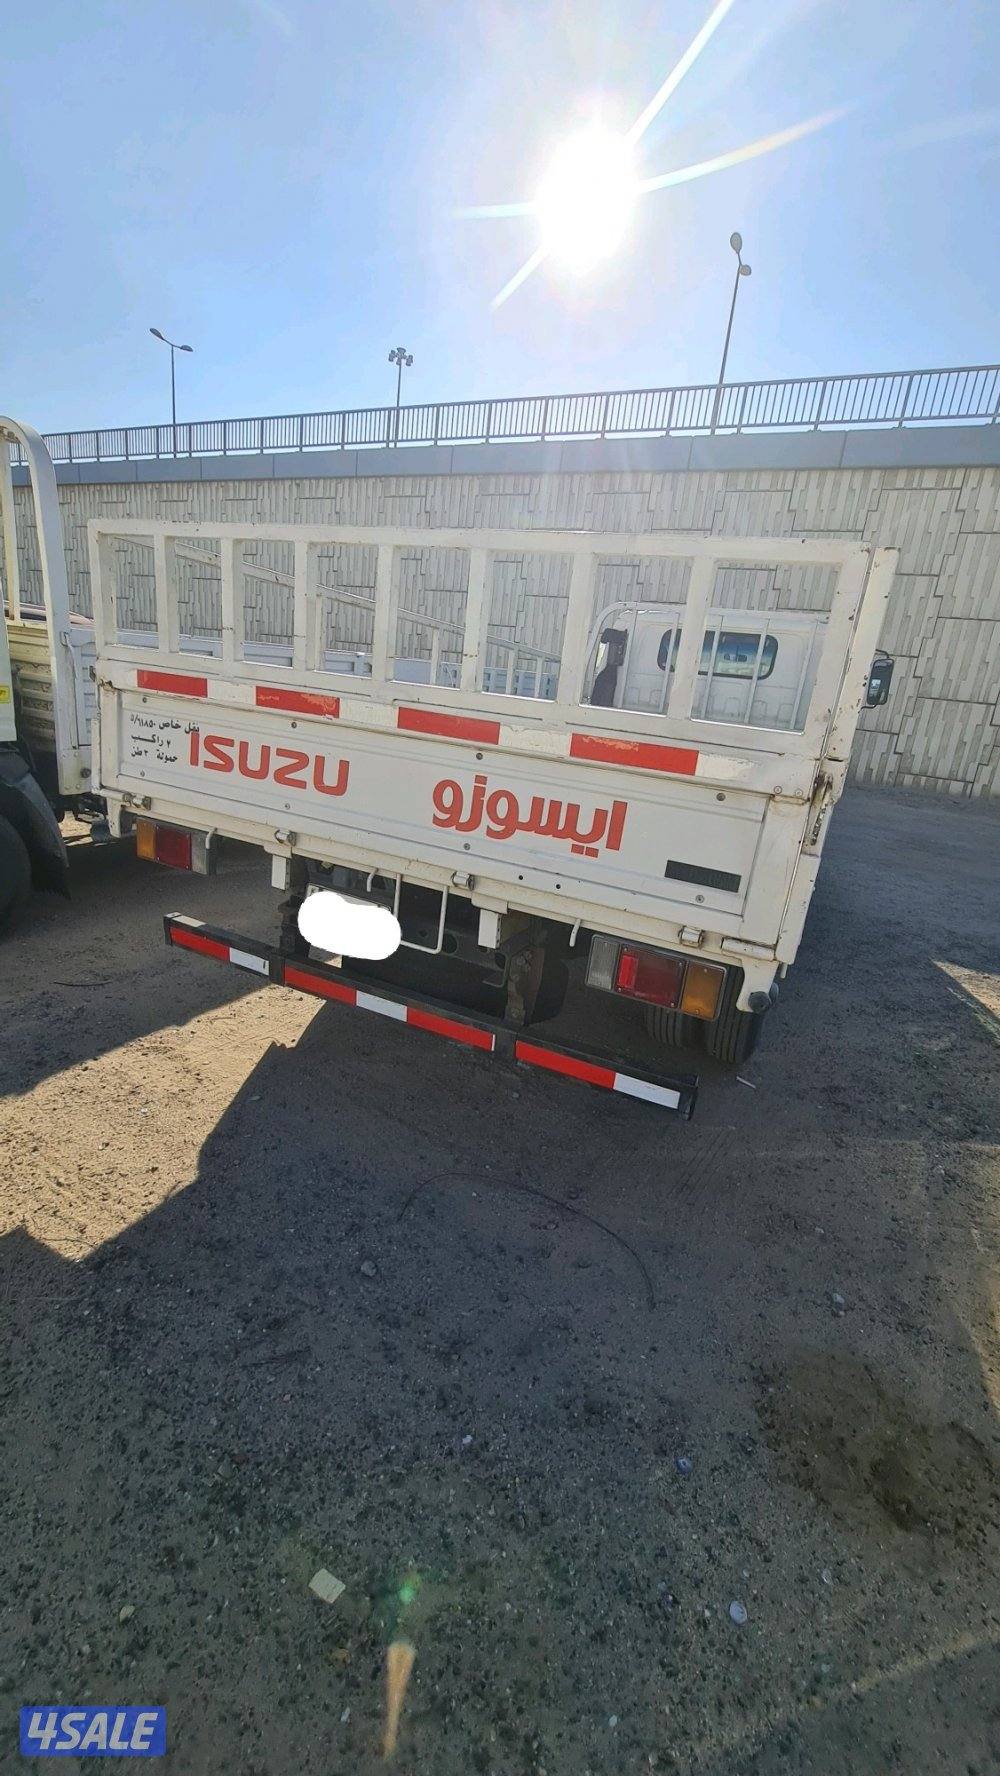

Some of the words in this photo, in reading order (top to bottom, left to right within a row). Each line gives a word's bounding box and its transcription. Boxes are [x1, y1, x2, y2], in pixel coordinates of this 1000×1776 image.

[159, 719, 181, 730] خاص
[189, 731, 350, 796] ISUZU
[432, 774, 628, 858] ايسوزو
